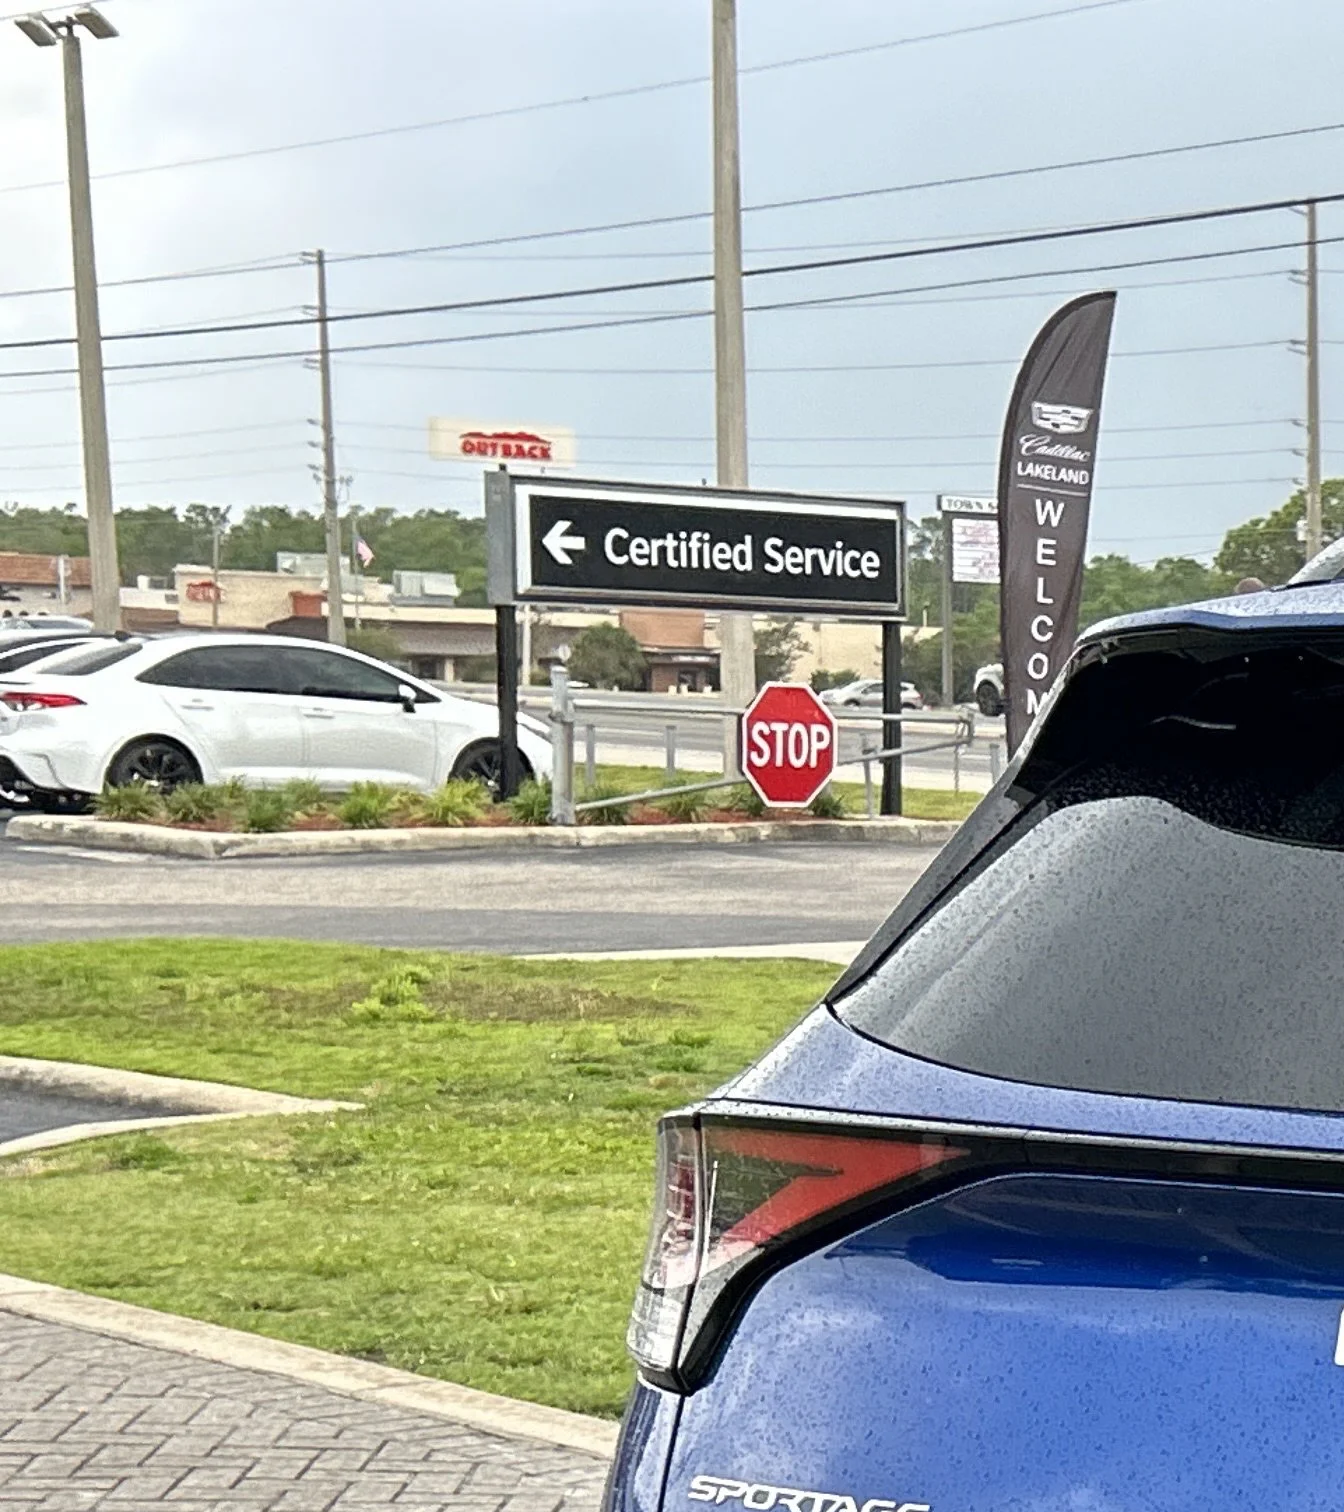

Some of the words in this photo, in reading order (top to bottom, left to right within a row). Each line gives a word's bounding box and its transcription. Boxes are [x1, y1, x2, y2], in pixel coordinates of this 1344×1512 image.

[461, 439, 552, 460] OUTBACK
[1019, 434, 1091, 462] Cadillac
[1017, 461, 1089, 485] LAKELAND
[604, 527, 752, 571] Certified
[764, 536, 881, 578] Service
[751, 721, 830, 769] STOP
